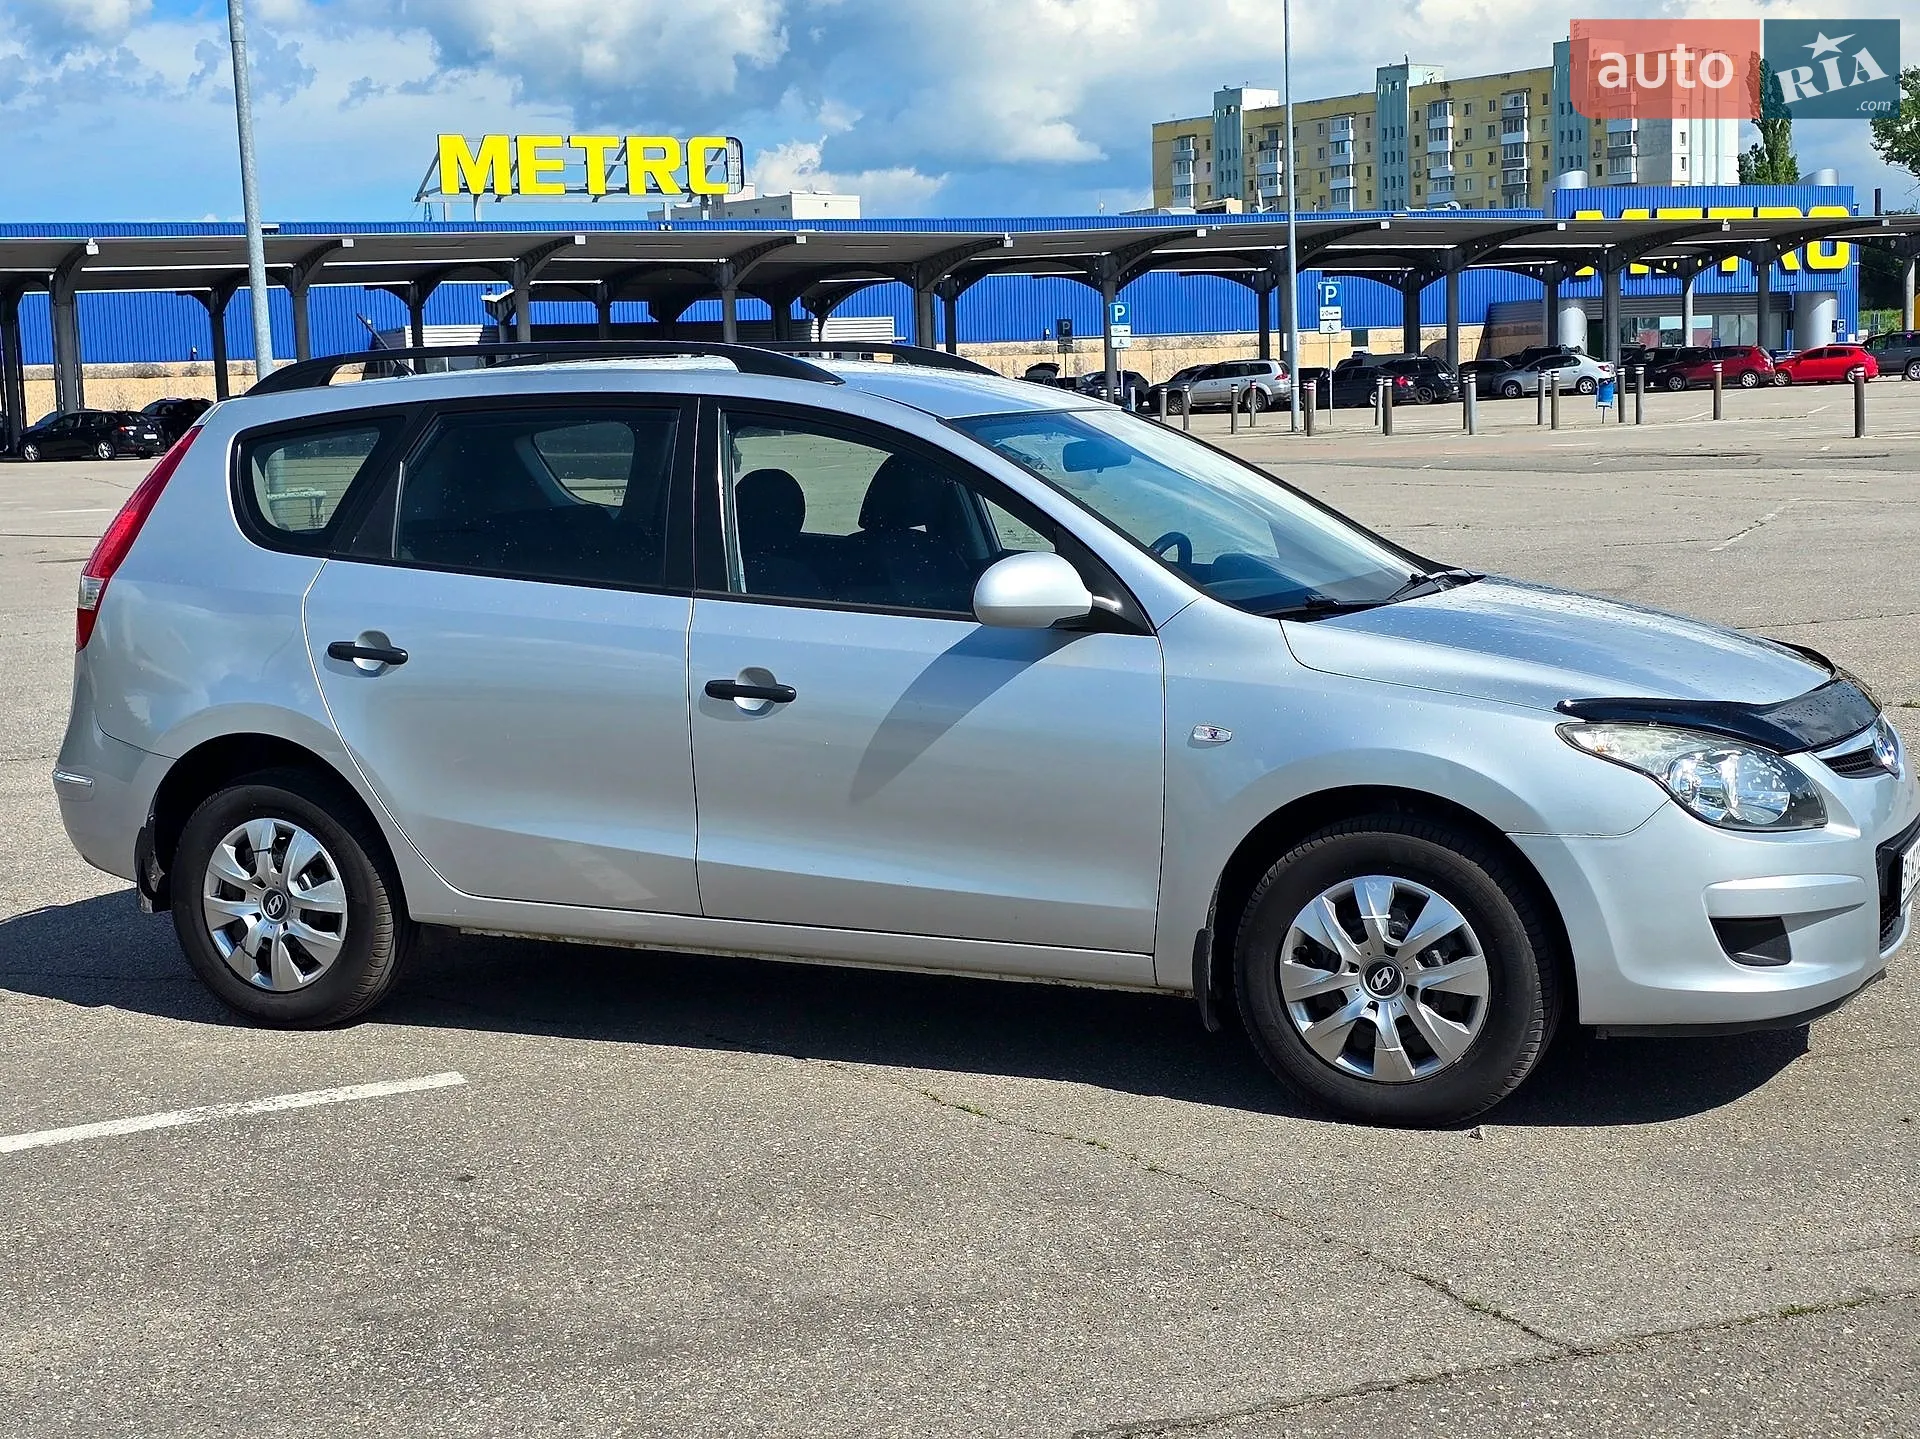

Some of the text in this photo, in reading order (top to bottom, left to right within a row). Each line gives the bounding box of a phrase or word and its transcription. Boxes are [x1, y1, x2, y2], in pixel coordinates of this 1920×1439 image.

[437, 134, 745, 195] METRO
[1325, 285, 1337, 305] P
[1114, 304, 1126, 322] P
